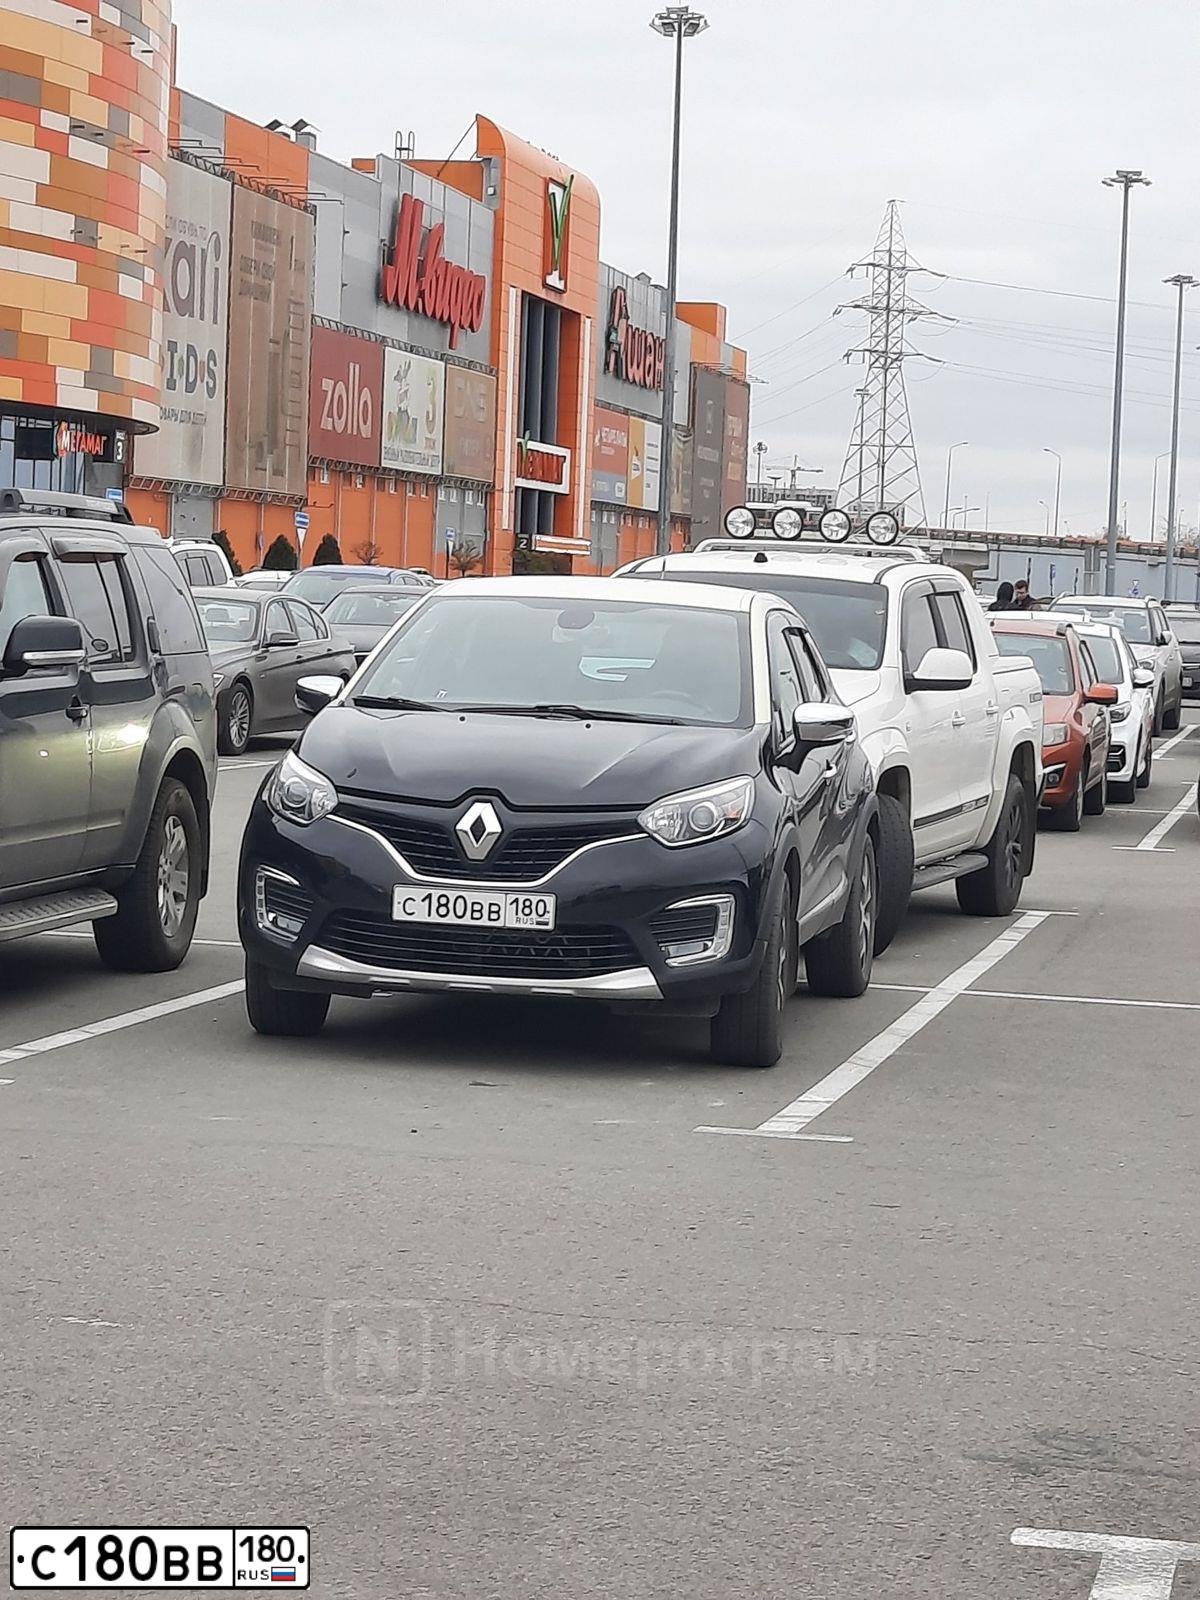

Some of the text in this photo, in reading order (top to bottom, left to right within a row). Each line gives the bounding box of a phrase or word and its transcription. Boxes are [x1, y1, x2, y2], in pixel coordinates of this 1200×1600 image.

[166, 340, 217, 399] IDS
[320, 362, 374, 438] zolla
[116, 441, 123, 460] 3
[520, 538, 527, 549] 2
[402, 892, 547, 922] С180ВВ 180
[515, 917, 534, 925] RUS
